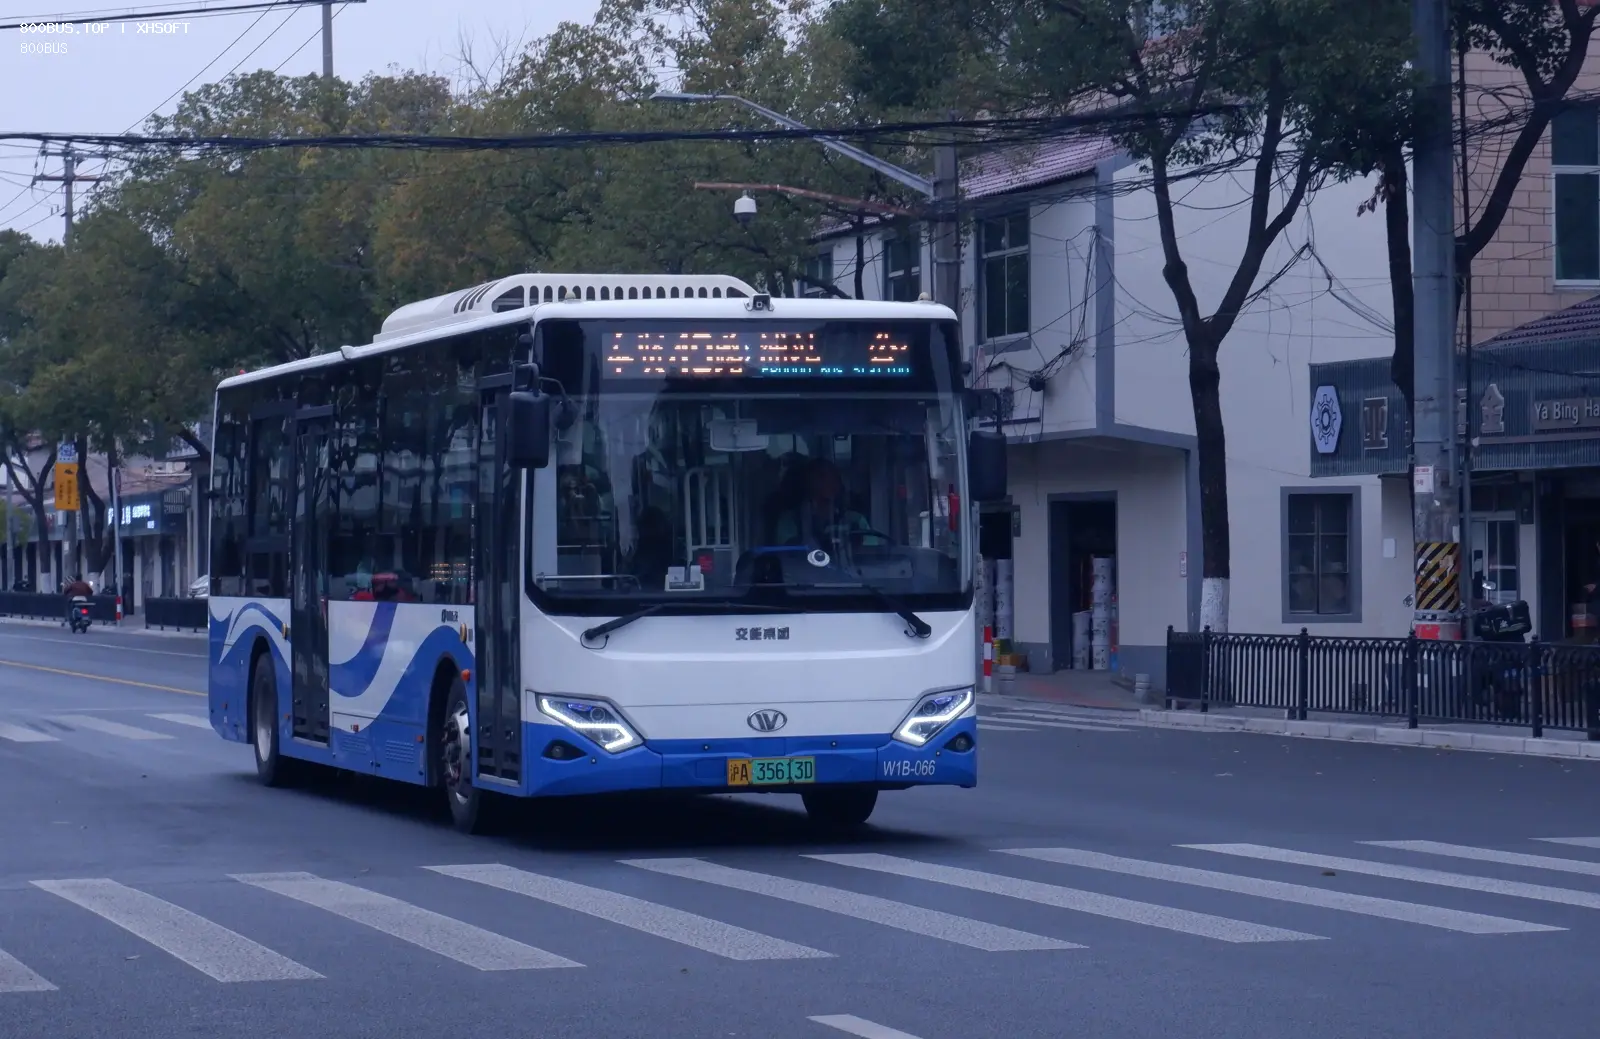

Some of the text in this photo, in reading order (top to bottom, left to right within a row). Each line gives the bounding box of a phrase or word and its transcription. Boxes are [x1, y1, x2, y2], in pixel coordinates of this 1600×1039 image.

[1534, 403, 1549, 421] Ya
[1553, 401, 1579, 425] Bing
[883, 760, 936, 776] W1B-066
